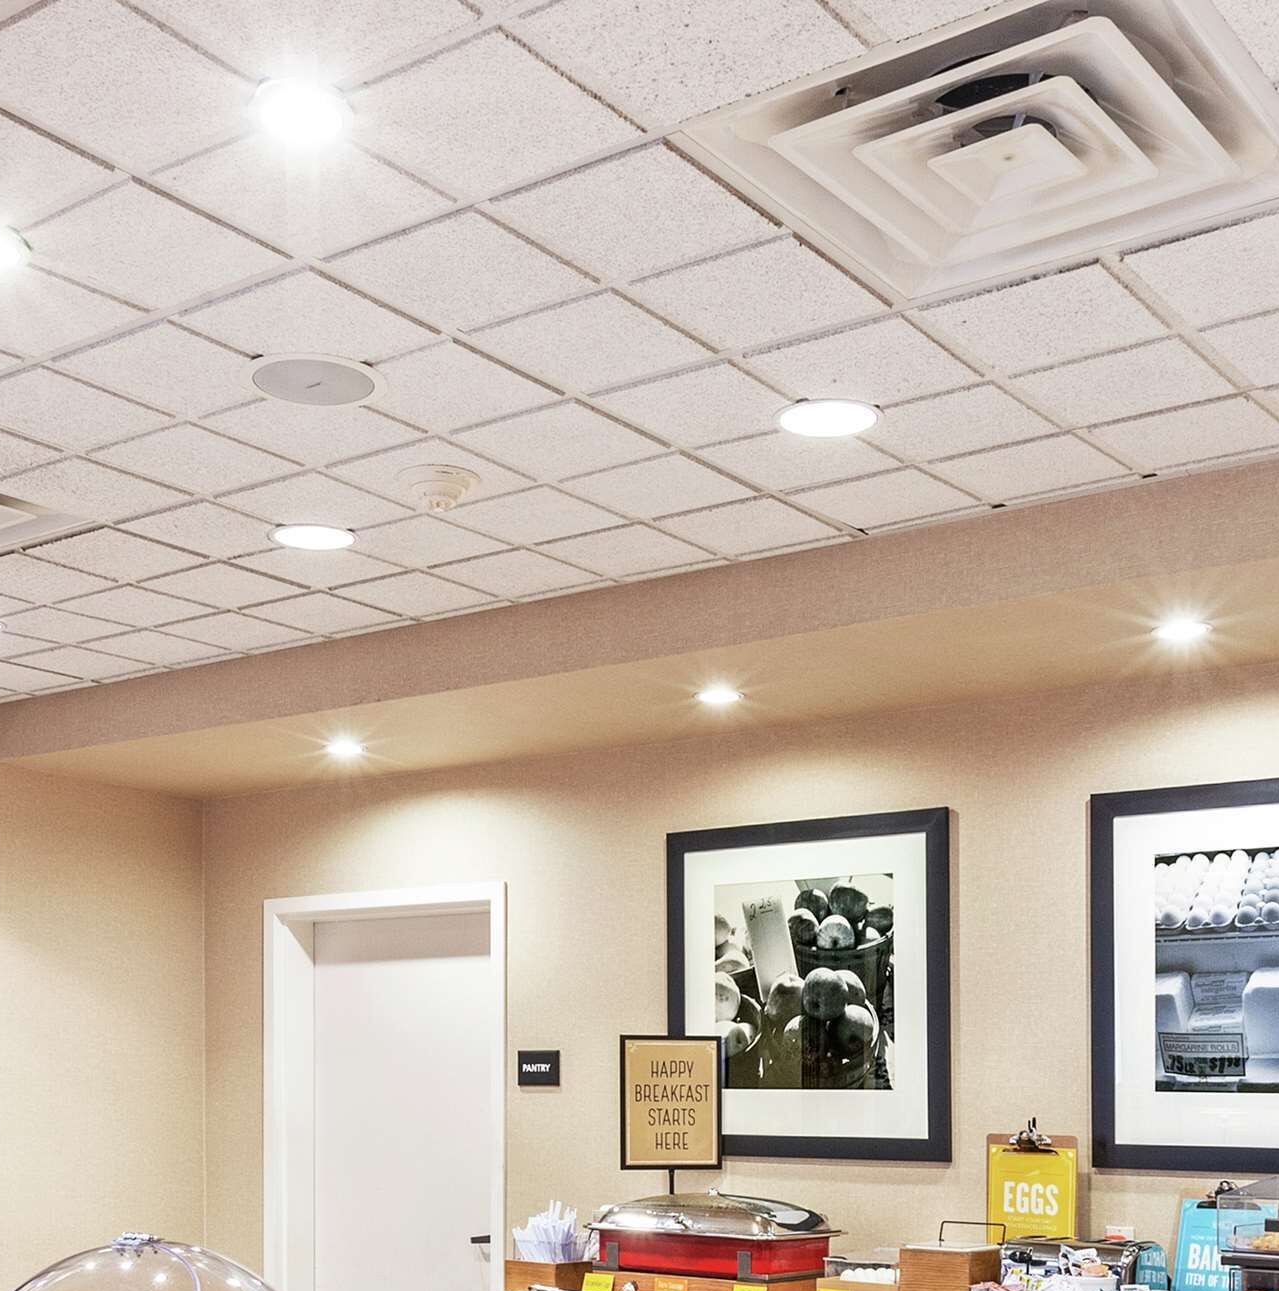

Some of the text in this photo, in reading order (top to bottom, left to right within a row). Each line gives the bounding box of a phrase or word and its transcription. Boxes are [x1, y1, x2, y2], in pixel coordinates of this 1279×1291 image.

[1210, 1042, 1238, 1052] ROLLS
[522, 1063, 551, 1073] PANTRY
[650, 1060, 694, 1078] HAPPY
[634, 1084, 710, 1102] BREAKFAST
[648, 1108, 696, 1126] STARTS
[655, 1132, 689, 1150] HERE
[1003, 1180, 1059, 1216] EGGS
[1185, 1272, 1207, 1286] ITEM
[1208, 1274, 1219, 1288] OF
